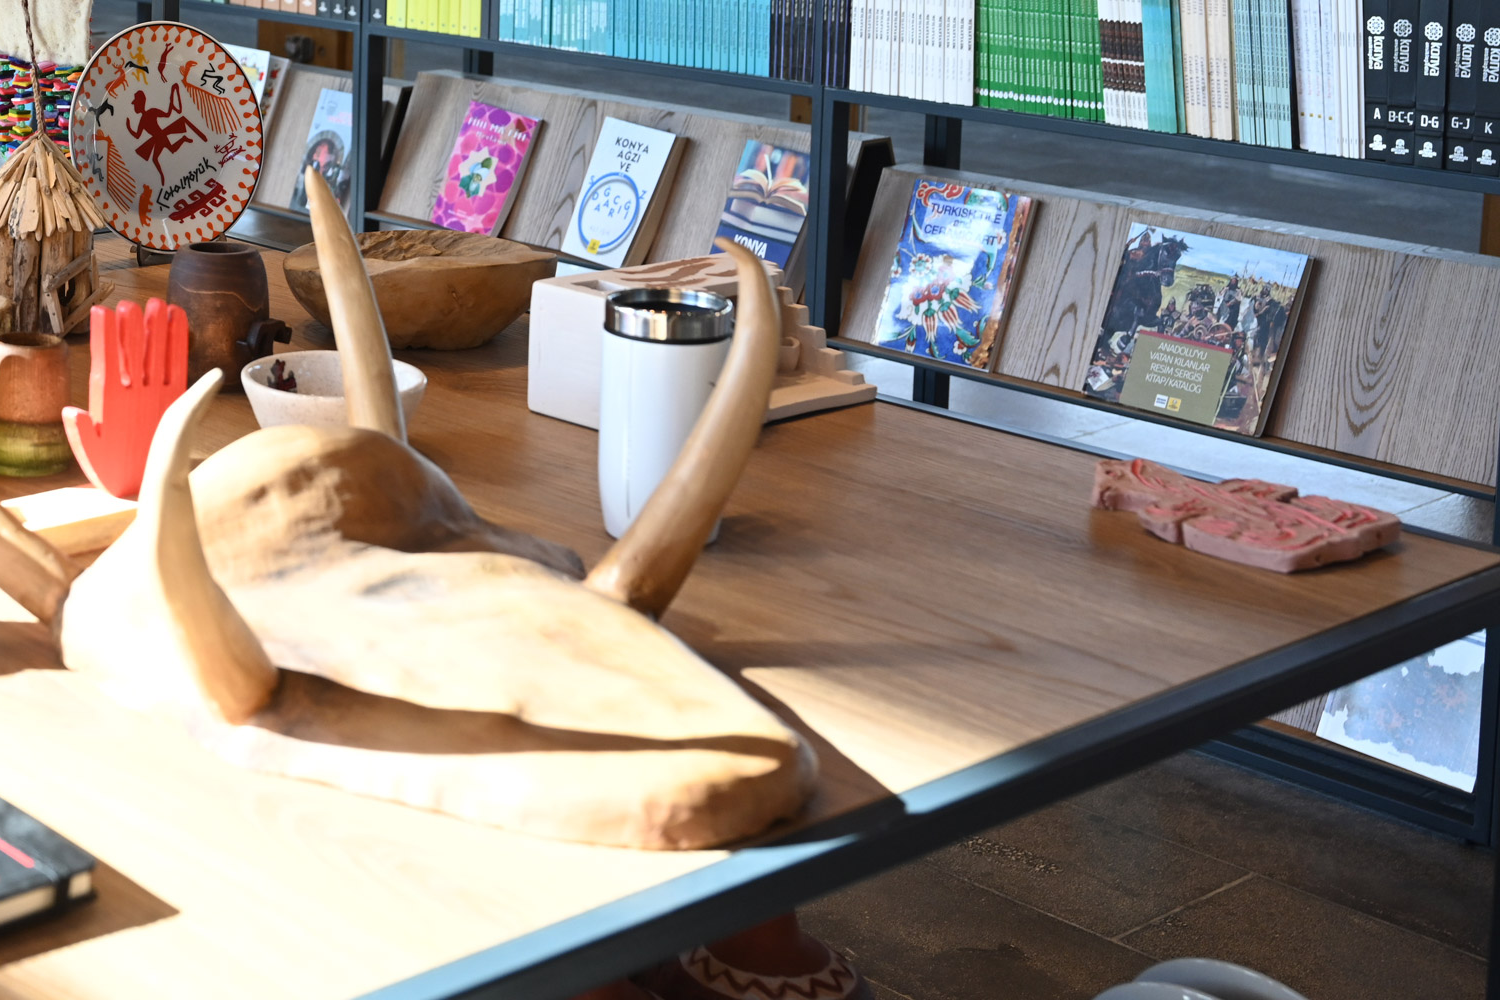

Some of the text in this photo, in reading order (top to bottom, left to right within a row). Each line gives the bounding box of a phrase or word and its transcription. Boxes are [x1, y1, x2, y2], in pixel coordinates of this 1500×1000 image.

[1373, 35, 1385, 70] konya
[1400, 38, 1412, 73] konya
[1430, 42, 1442, 77] konya
[1461, 44, 1475, 79] konya
[1489, 48, 1500, 83] konya
[1373, 108, 1381, 120] A
[1420, 115, 1439, 129] D-G
[1451, 113, 1470, 130] G-J
[1484, 122, 1492, 134] K
[615, 137, 649, 154] KONYA
[617, 149, 642, 163] AĞZI
[620, 162, 632, 172] VE
[1158, 342, 1208, 360] ANADOLU'YU
[1150, 351, 1210, 372] VATAN KILANLAR
[1150, 362, 1173, 374] RESİM
